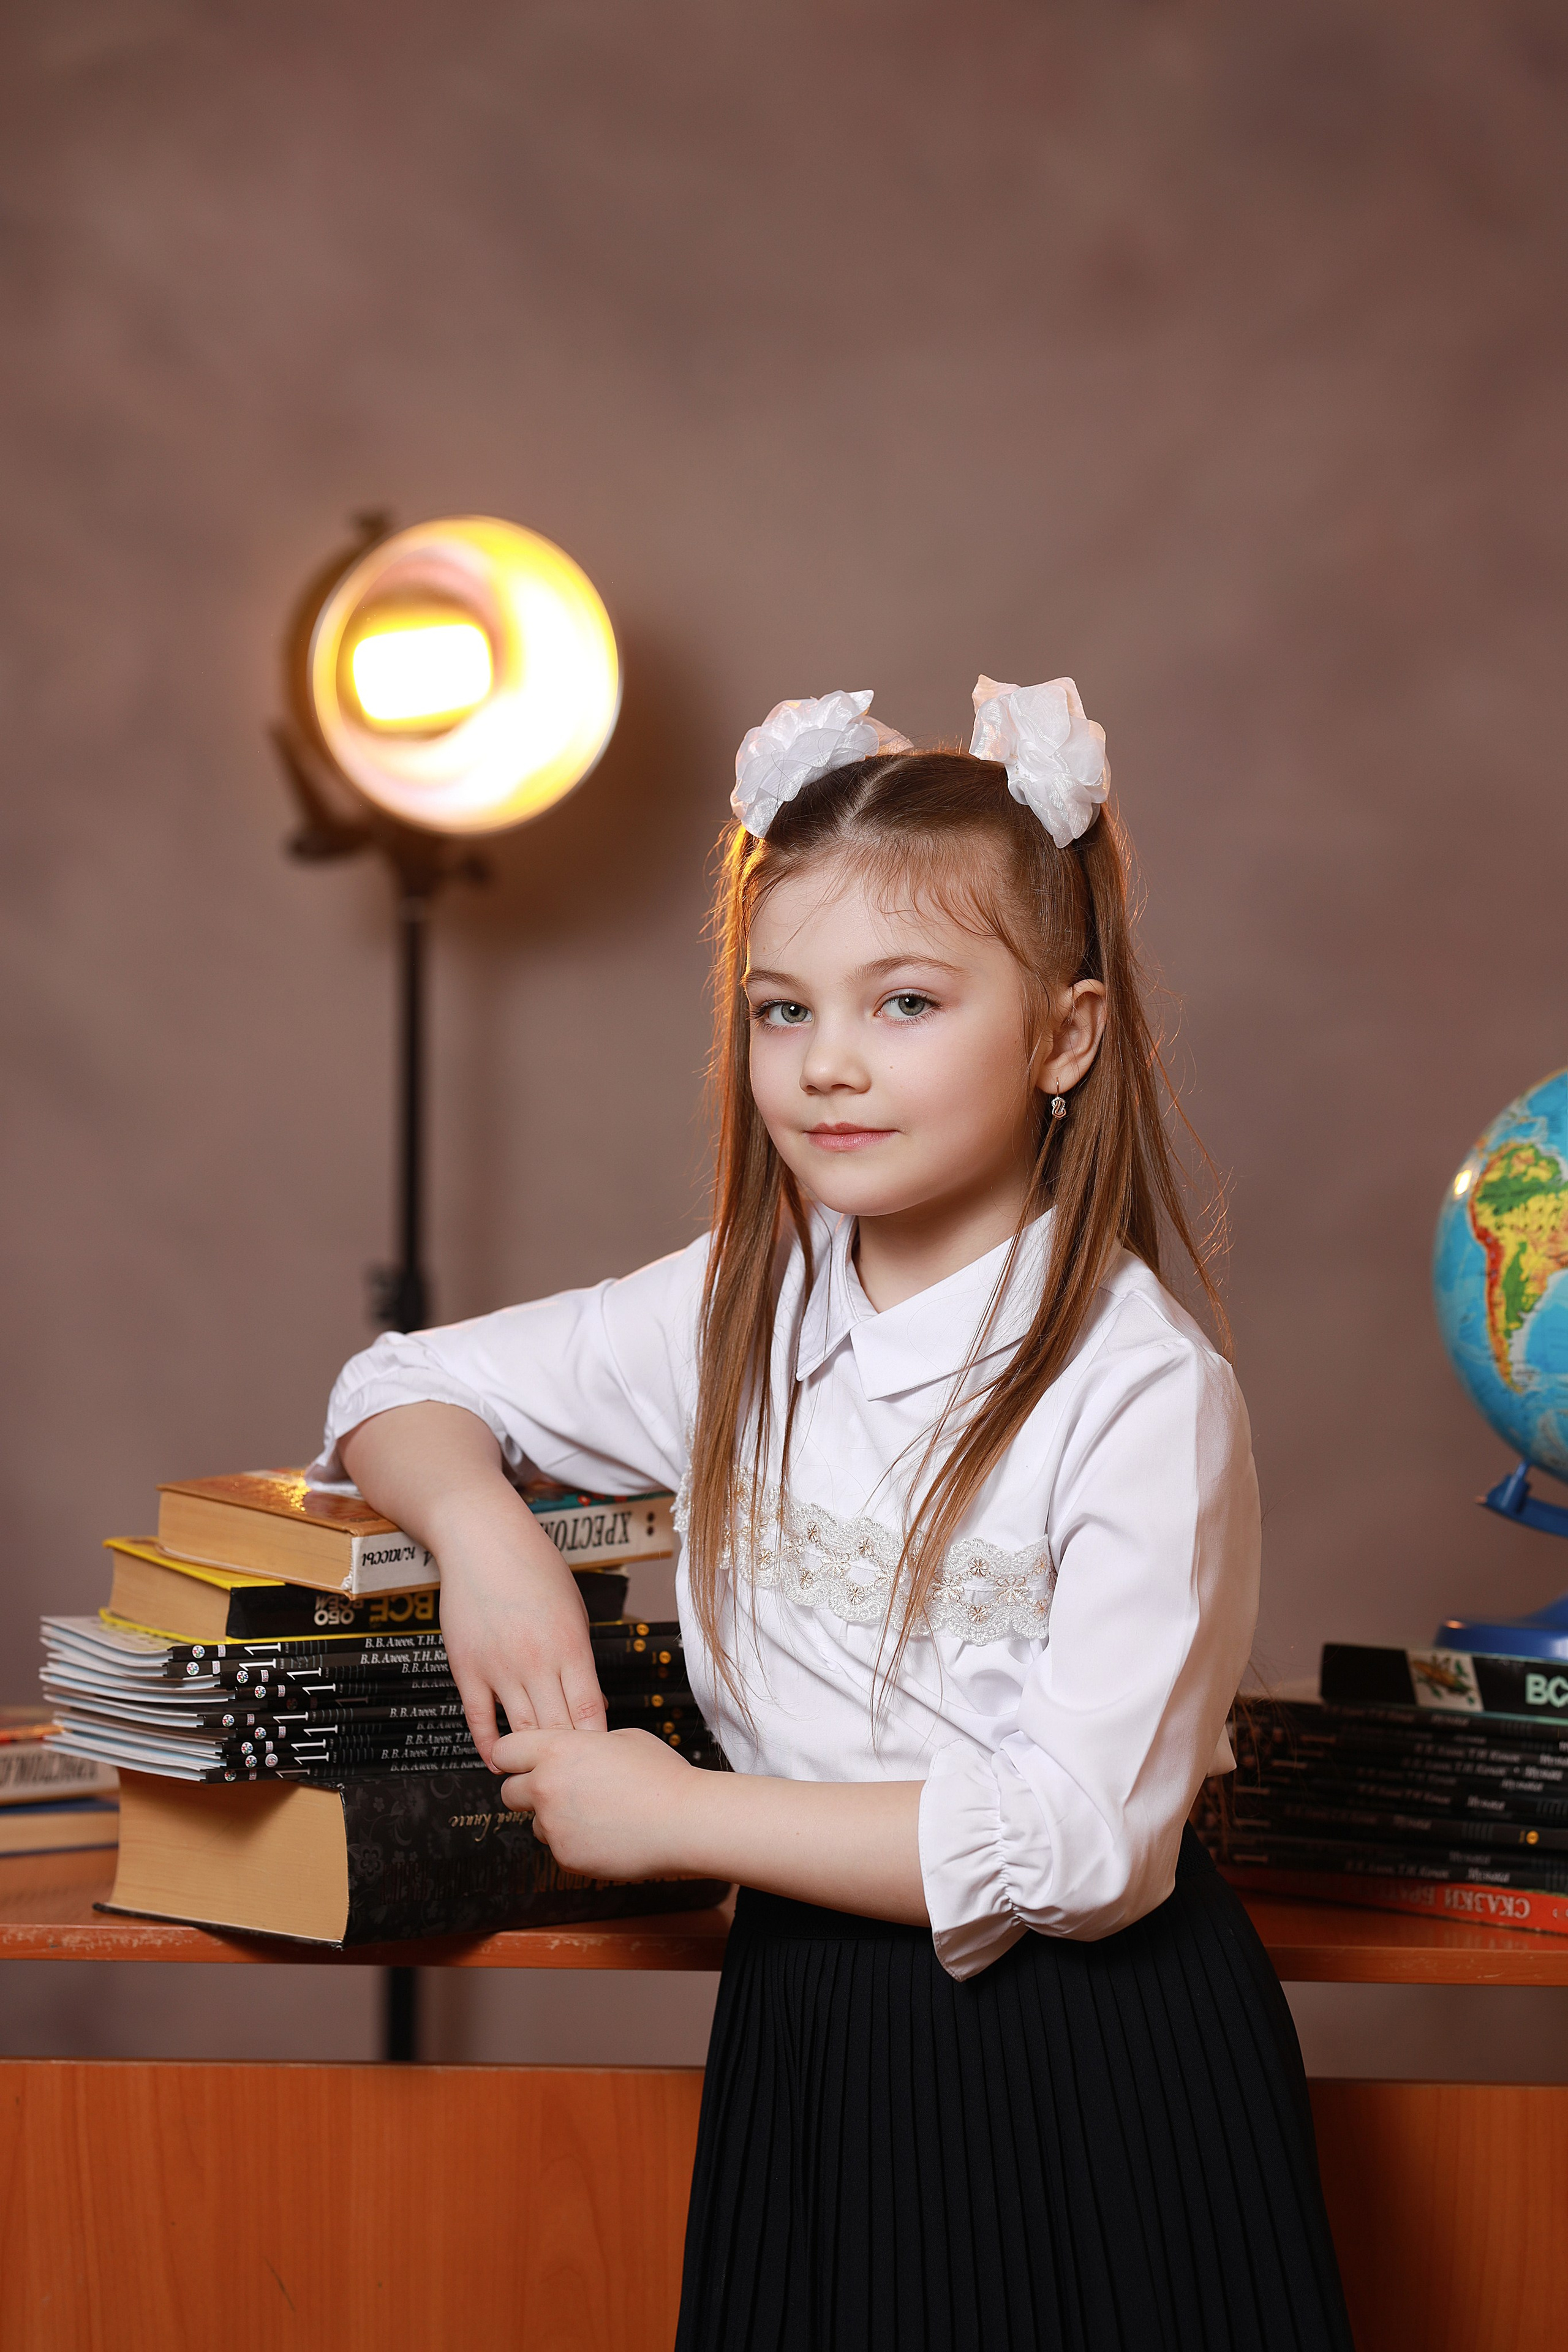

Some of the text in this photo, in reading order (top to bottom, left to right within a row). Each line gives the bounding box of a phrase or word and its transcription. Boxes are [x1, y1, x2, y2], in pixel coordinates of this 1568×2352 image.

[362, 1547, 415, 1566] классы
[314, 1610, 355, 1626] ОБО
[448, 1814, 491, 1842] книге
[1444, 1888, 1531, 1919] СКАЗКИ
